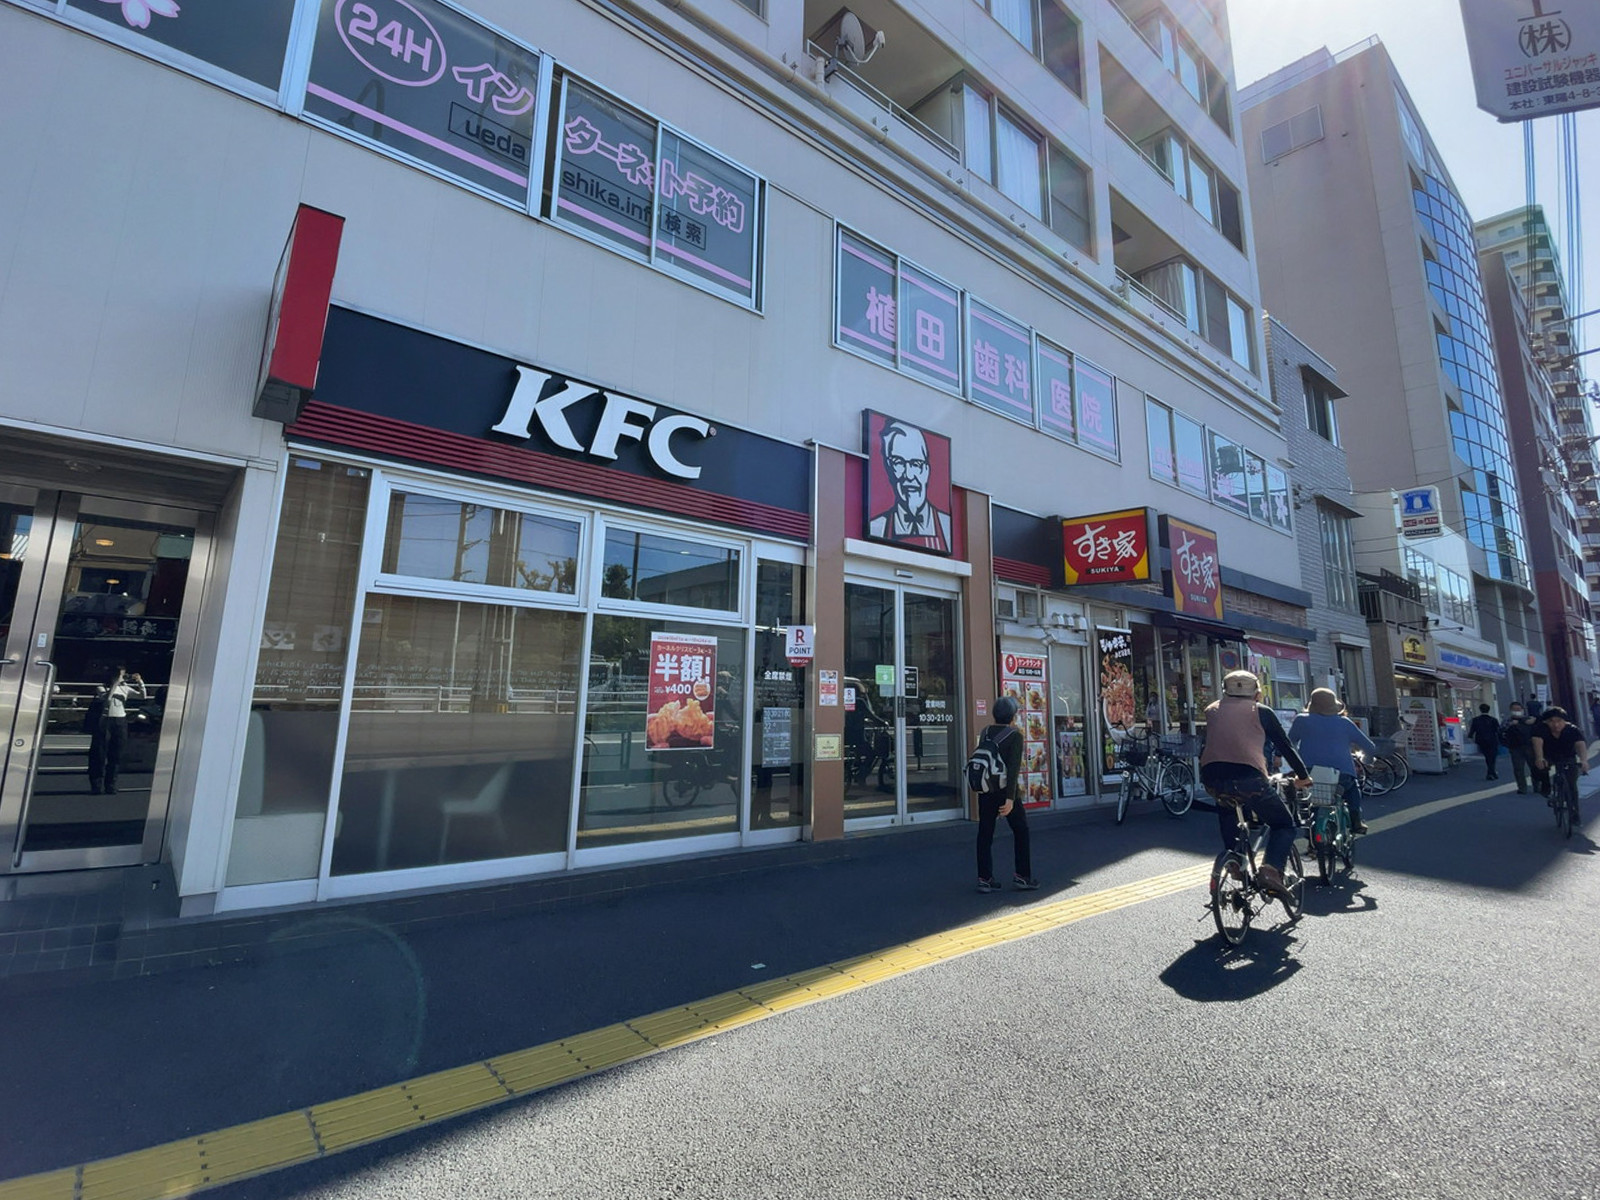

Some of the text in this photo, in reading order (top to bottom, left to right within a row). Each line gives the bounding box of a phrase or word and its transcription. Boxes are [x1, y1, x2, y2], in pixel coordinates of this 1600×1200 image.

[348, 2, 433, 73] 24H
[465, 119, 526, 162] ueda
[491, 364, 710, 480] KFC
[1072, 524, 1138, 565] すき家
[1176, 531, 1216, 594] すき家
[1090, 566, 1120, 575] SUKIYA
[789, 646, 812, 655] POINT
[795, 629, 805, 643] R
[655, 653, 712, 683] 半額!
